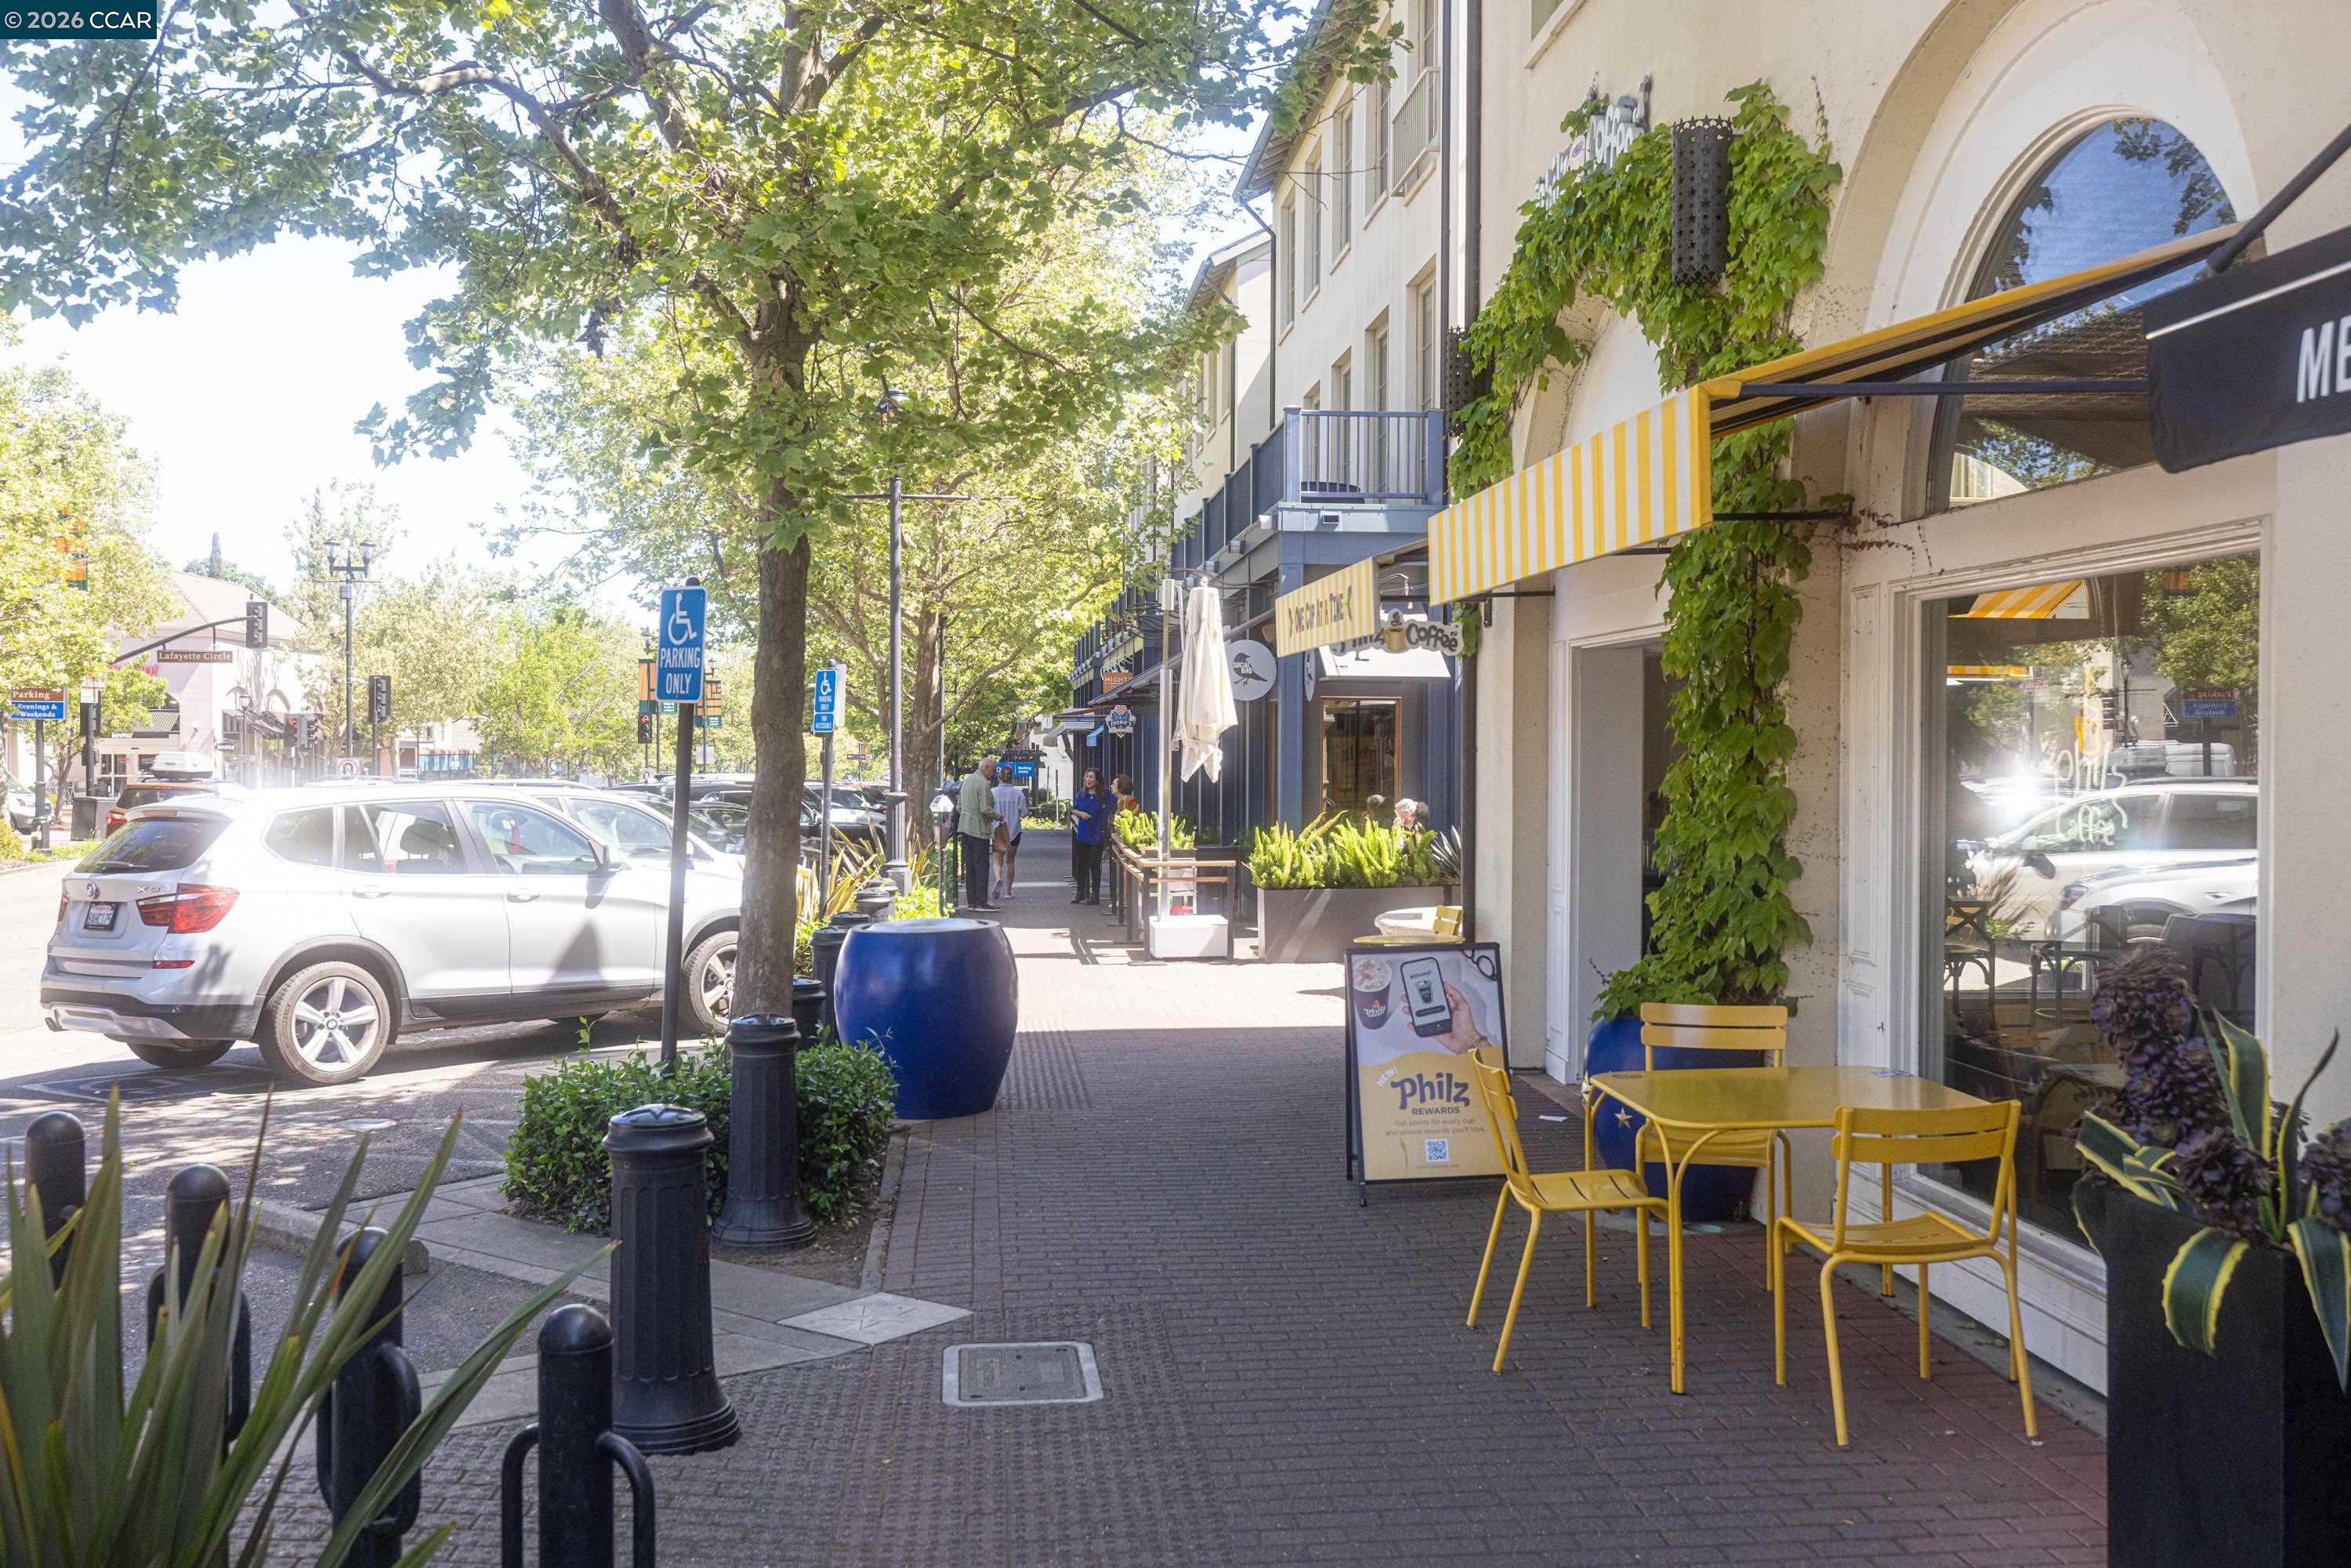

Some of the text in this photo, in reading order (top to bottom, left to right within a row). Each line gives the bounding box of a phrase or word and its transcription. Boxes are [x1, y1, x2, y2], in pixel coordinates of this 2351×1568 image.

[1295, 592, 1343, 633] ONE CUP AT A TIME
[1406, 622, 1458, 652] Coffee
[158, 652, 231, 661] Lafayette Circle
[660, 646, 701, 668] PARKING
[665, 673, 692, 694] ONLY
[13, 690, 50, 700] Parking
[1377, 1066, 1398, 1087] NEW!
[1390, 1071, 1470, 1110] Philz
[1411, 1106, 1461, 1115] REWARDS
[1408, 1119, 1429, 1128] points
[1462, 1117, 1475, 1126] cup
[1422, 1127, 1450, 1135] rewards
